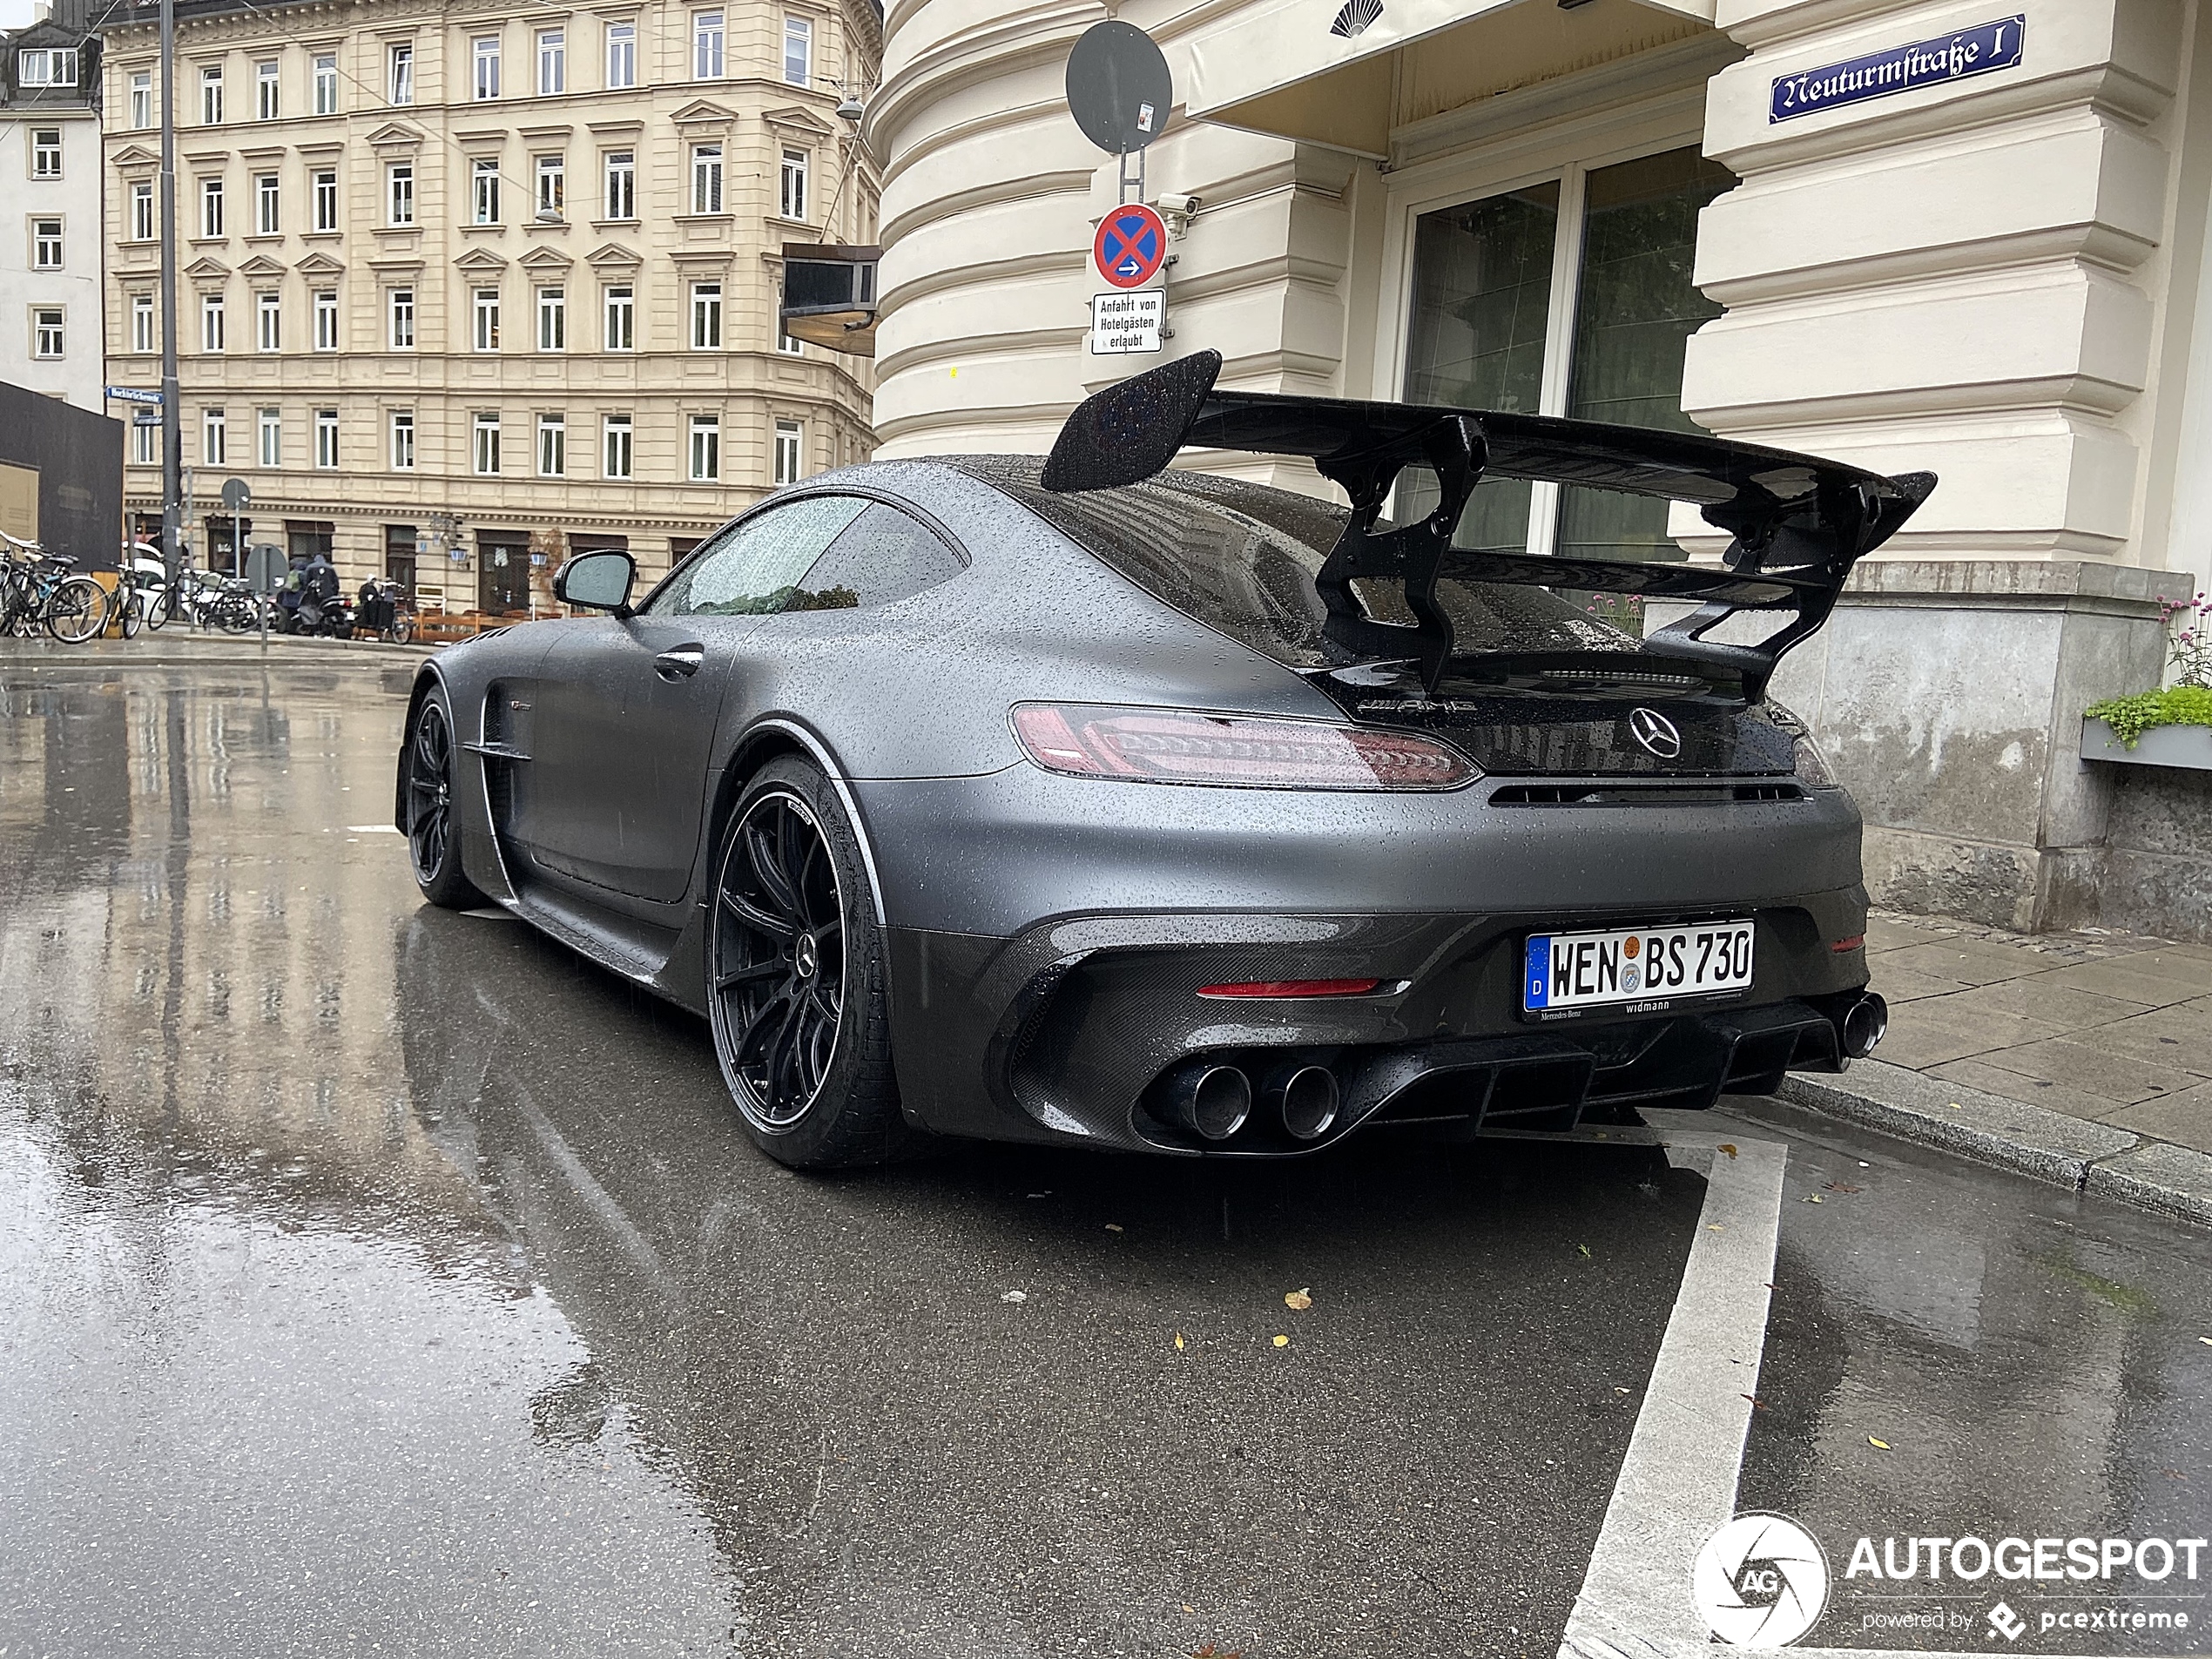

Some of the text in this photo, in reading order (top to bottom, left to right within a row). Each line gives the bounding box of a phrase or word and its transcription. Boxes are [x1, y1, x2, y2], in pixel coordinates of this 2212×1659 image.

[1101, 300, 1157, 313] Anfahrt von
[1101, 316, 1154, 332] Hotelgästen
[1109, 334, 1143, 347] erlaubt
[1533, 929, 1750, 998] D WEN BS 730
[1626, 1001, 1670, 1014] widmann
[1541, 1010, 1581, 1022] Mercedes-Benz
